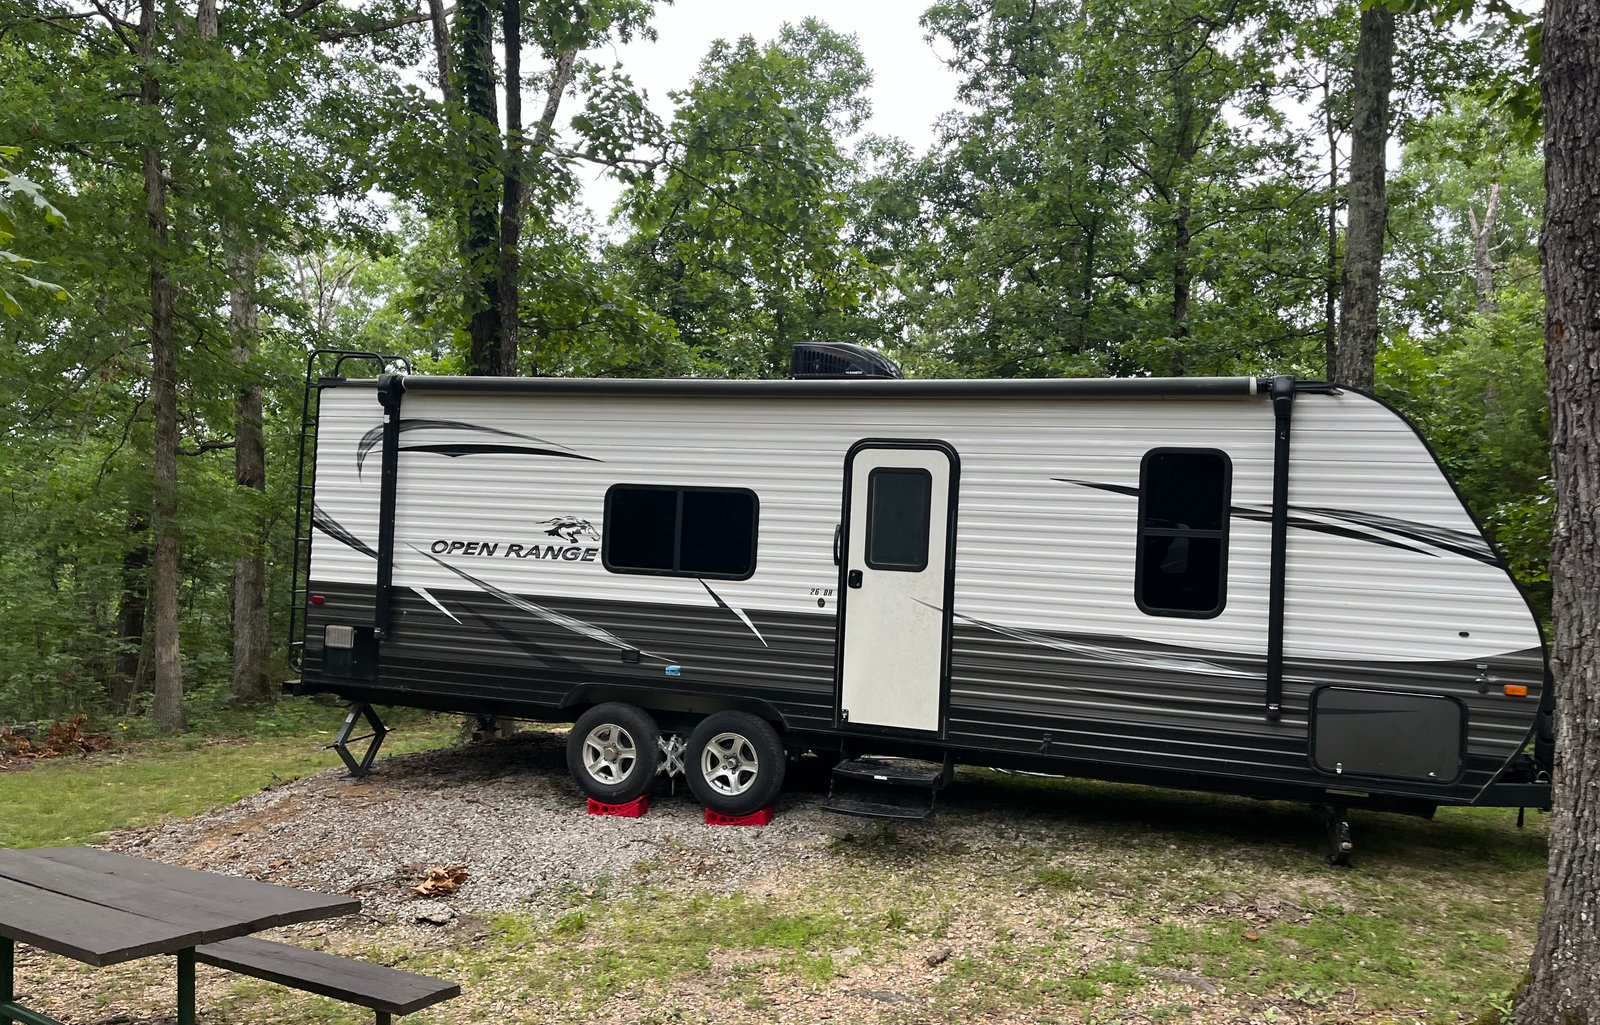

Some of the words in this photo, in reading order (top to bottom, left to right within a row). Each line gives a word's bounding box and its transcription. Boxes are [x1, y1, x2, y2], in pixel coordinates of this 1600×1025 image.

[431, 540, 498, 556] OPEN
[504, 544, 599, 562] RANGE
[810, 588, 820, 596] 26
